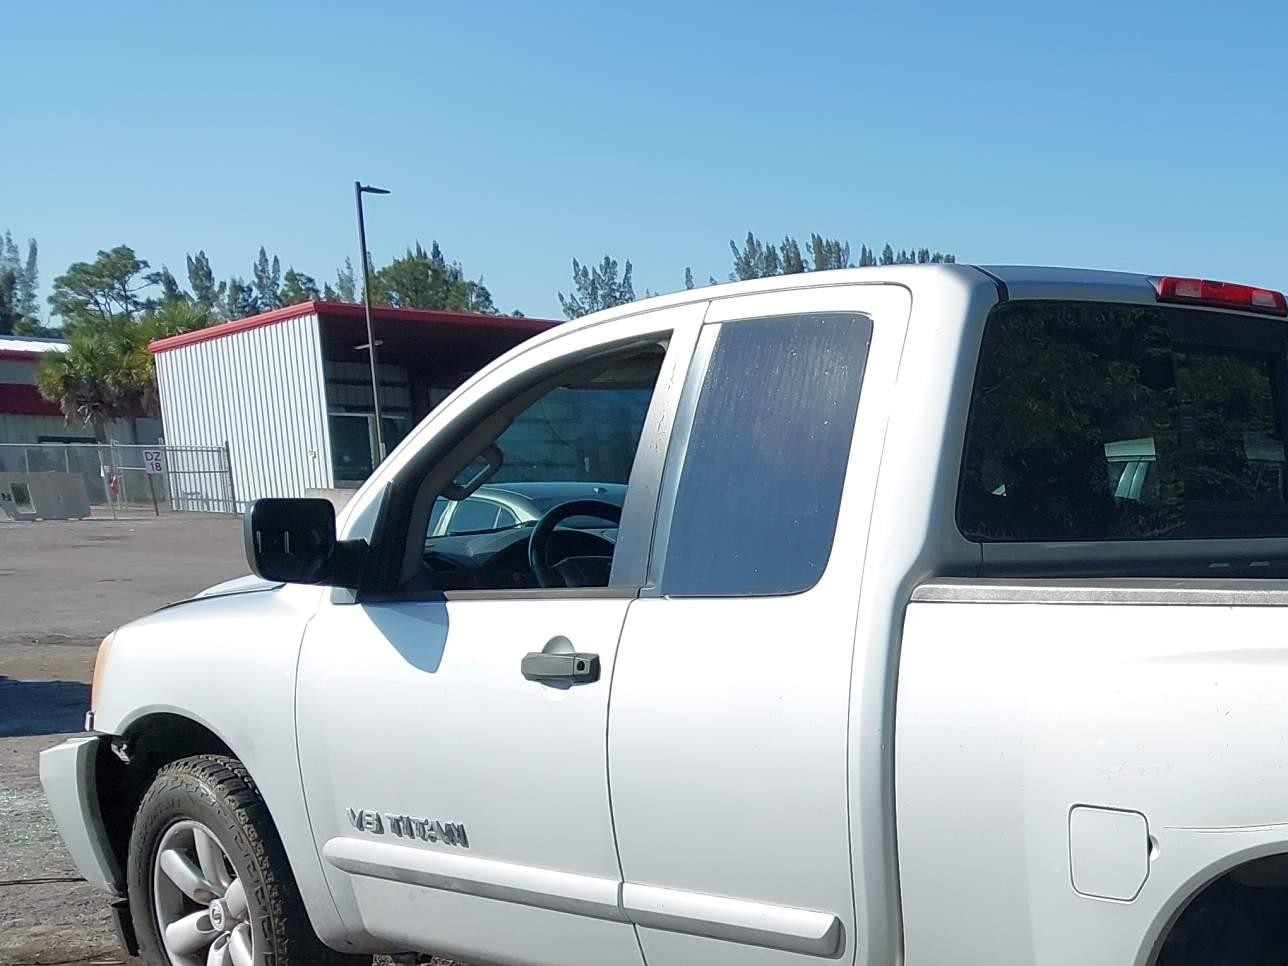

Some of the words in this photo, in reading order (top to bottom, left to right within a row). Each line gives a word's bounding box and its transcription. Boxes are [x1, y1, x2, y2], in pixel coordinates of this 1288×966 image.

[144, 451, 161, 461] DZ
[150, 462, 161, 471] 18
[346, 807, 384, 835] V8
[384, 812, 469, 848] TITAN
